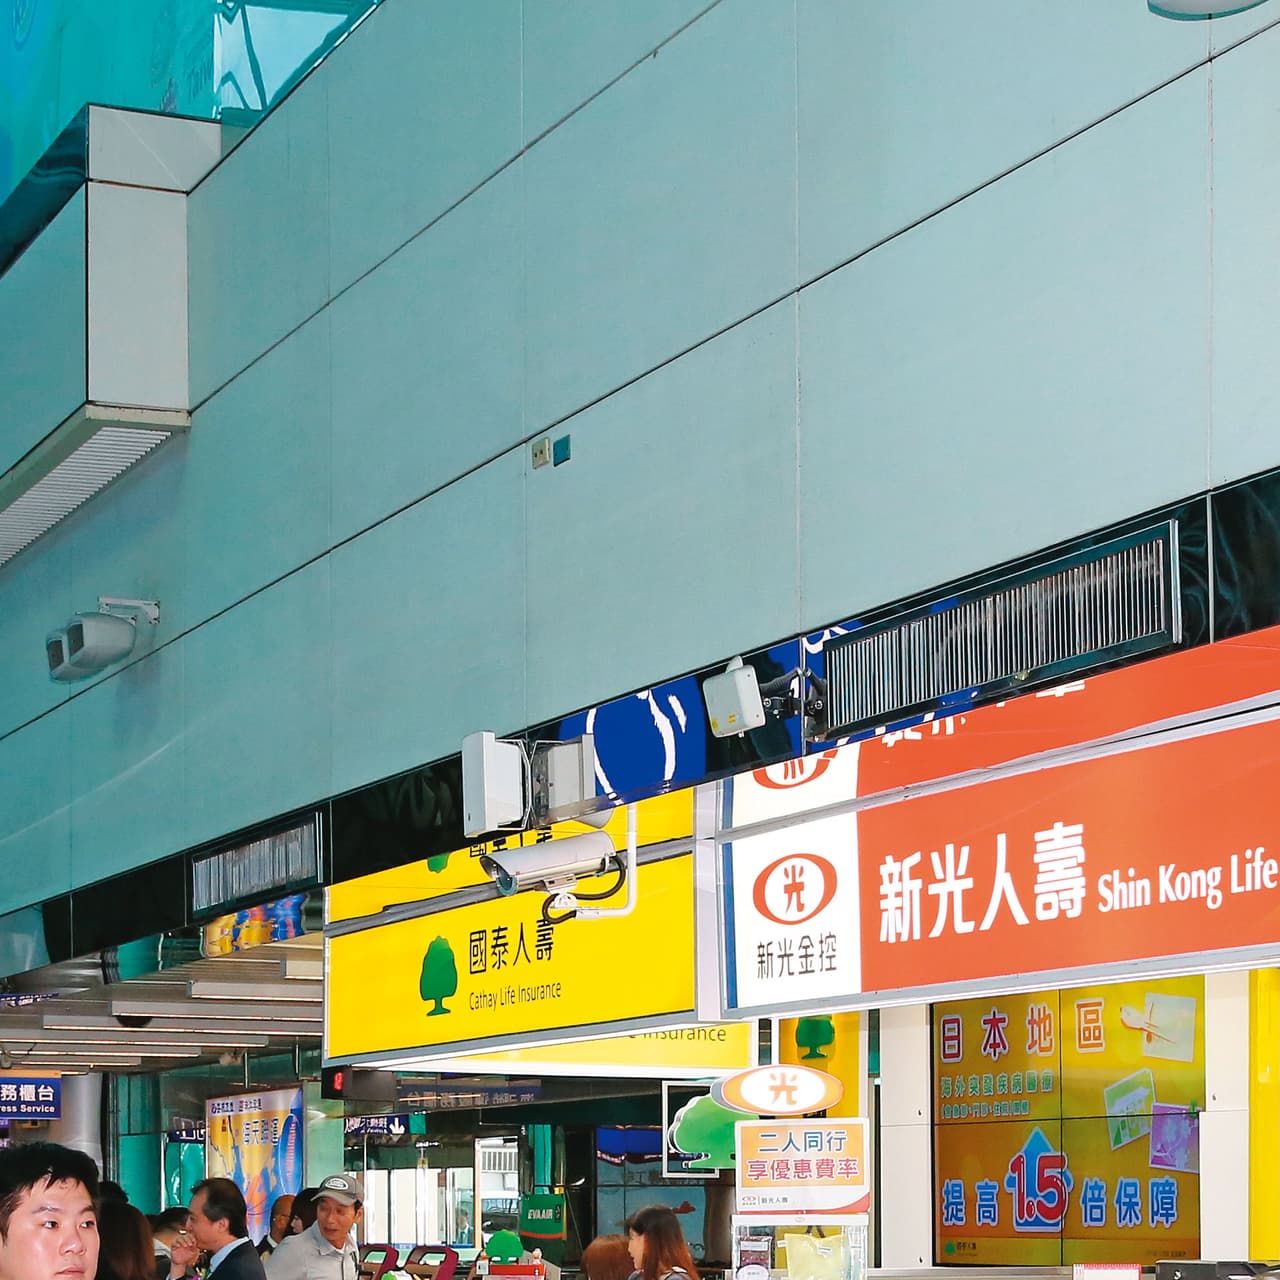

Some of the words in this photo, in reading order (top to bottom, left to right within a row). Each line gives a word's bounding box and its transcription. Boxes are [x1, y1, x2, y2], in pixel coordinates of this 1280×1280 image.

[878, 820, 1088, 945] 新光人壽
[1097, 862, 1152, 911] Shin
[1158, 856, 1223, 911] Kong
[1230, 846, 1279, 893] Life
[469, 918, 555, 975] 國泰人壽
[756, 930, 838, 981] 新光金控
[469, 989, 498, 1012] Cathay
[500, 985, 517, 1006] Life
[518, 980, 562, 1003] Insurance
[940, 998, 1106, 1064] 日本地區
[20, 1104, 55, 1113] Service
[757, 1130, 848, 1154] 二人同行
[747, 1157, 859, 1182] 享優惠費率
